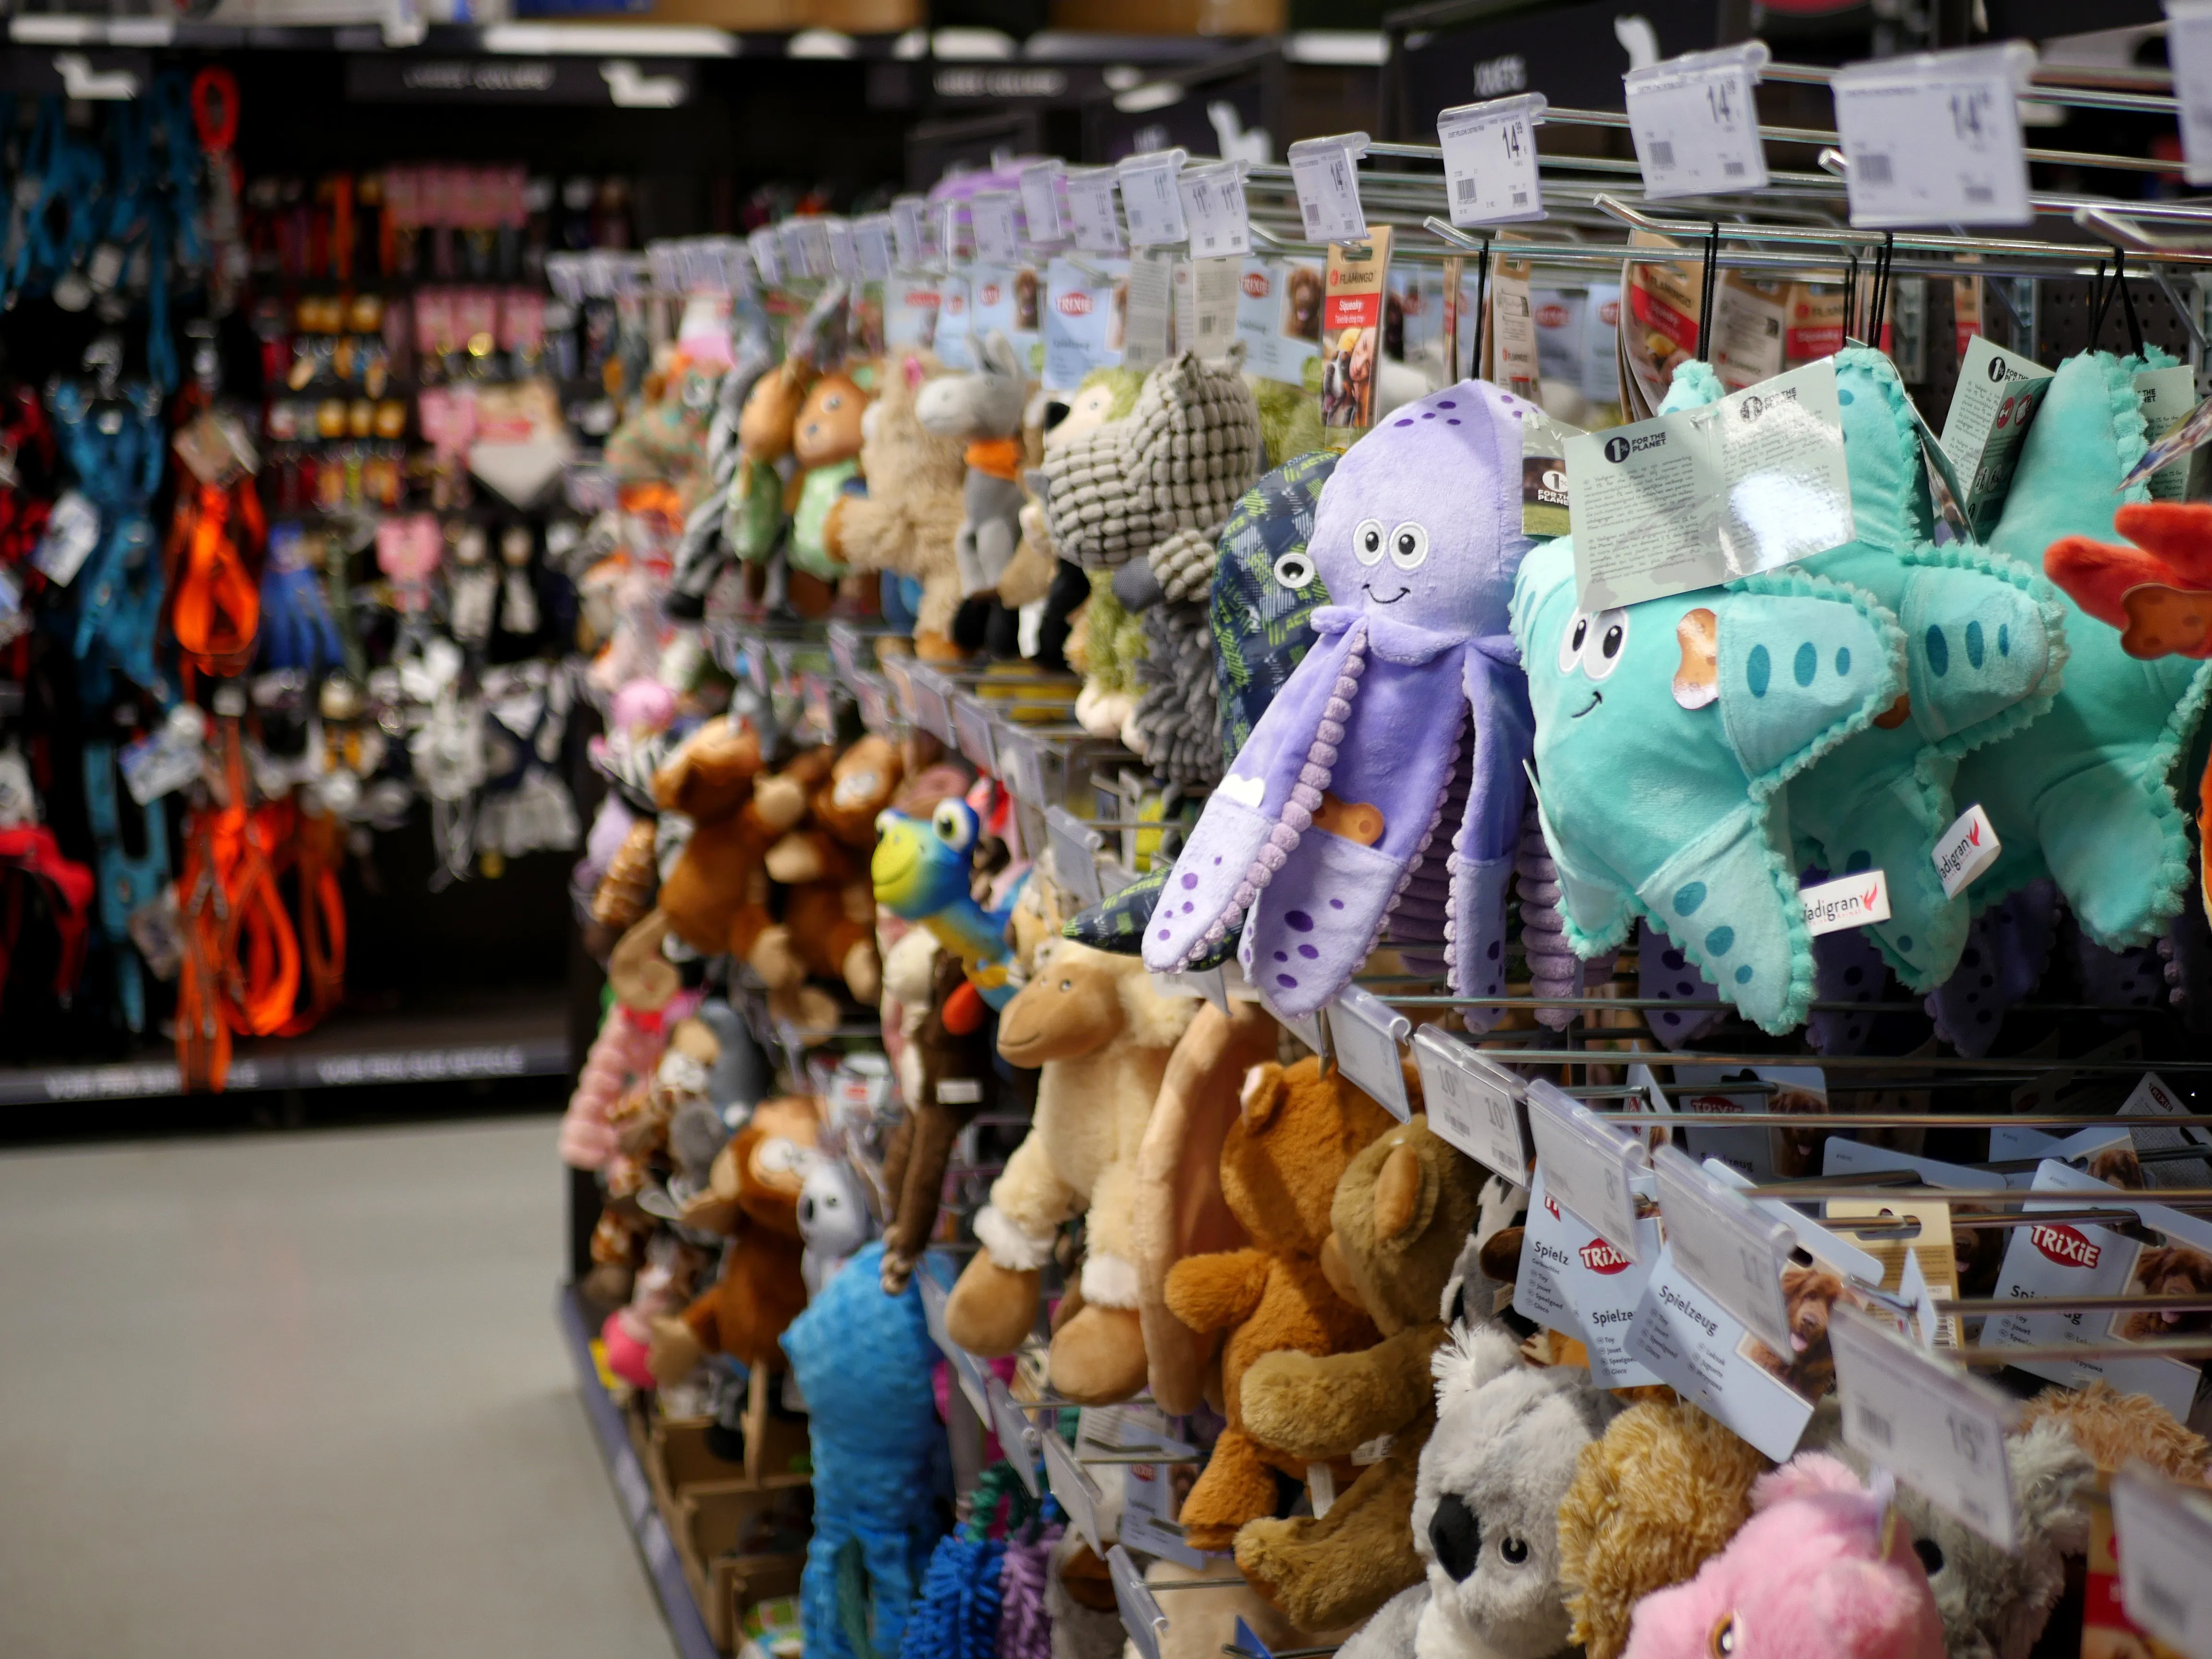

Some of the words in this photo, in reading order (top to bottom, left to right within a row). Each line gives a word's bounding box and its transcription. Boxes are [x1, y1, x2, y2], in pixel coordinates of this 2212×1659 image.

[1502, 124, 1519, 159] 14
[1340, 271, 1373, 284] FLAMINGO
[1339, 298, 1364, 313] Squeaky
[2006, 369, 2018, 378] FOR
[1780, 387, 1796, 396] THE
[1632, 437, 1648, 446] FOR
[1650, 432, 1666, 441] THE
[1633, 438, 1666, 453] PLANET
[1538, 489, 1556, 498] FOR
[1557, 493, 1569, 502] TH
[1538, 494, 1569, 506] PLANE
[1534, 1240, 1570, 1266] Spielz
[1580, 1245, 1628, 1267] TRiX
[1538, 1273, 1549, 1283] Toy
[1659, 1284, 1719, 1337] Spielzeug
[1592, 1309, 1634, 1327] Spielze
[1604, 1336, 1615, 1345] Toy
